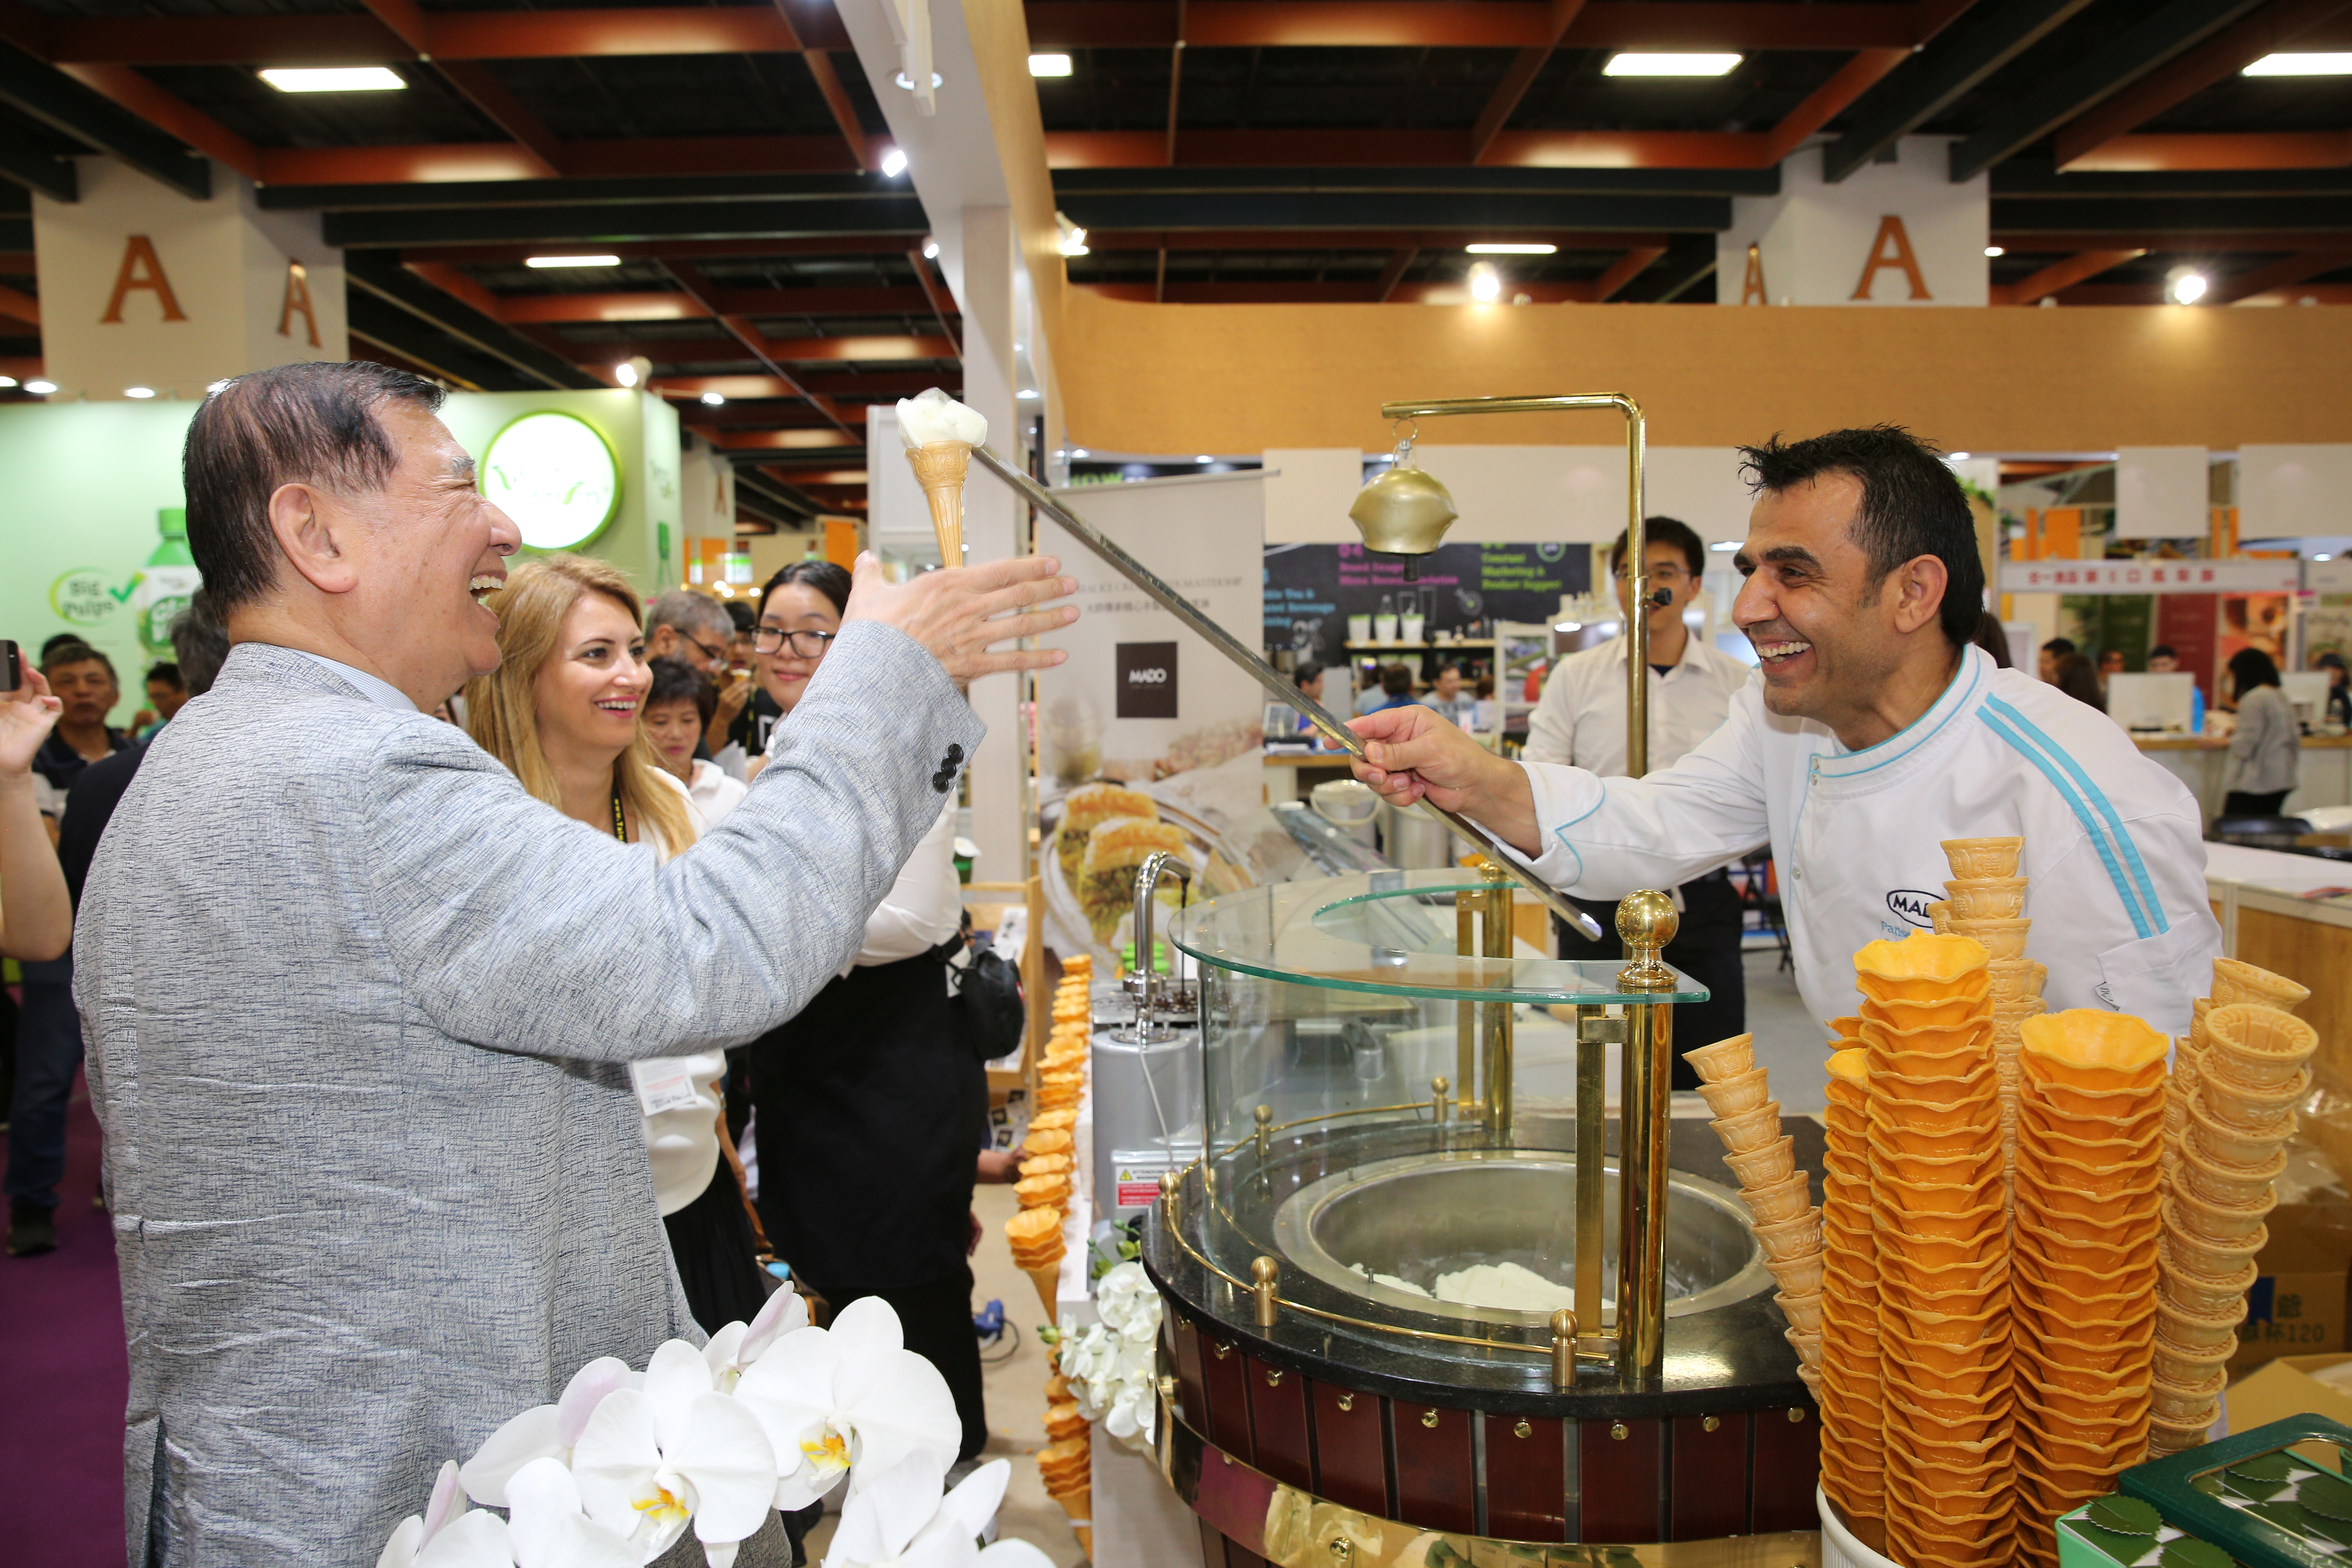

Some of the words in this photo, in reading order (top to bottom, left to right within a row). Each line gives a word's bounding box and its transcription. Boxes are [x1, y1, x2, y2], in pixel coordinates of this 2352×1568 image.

[99, 234, 188, 323] A
[1851, 215, 1933, 300] A
[276, 258, 322, 348] A
[69, 579, 100, 596] Big
[1129, 668, 1167, 684] MADO
[1893, 894, 1930, 918] MAD
